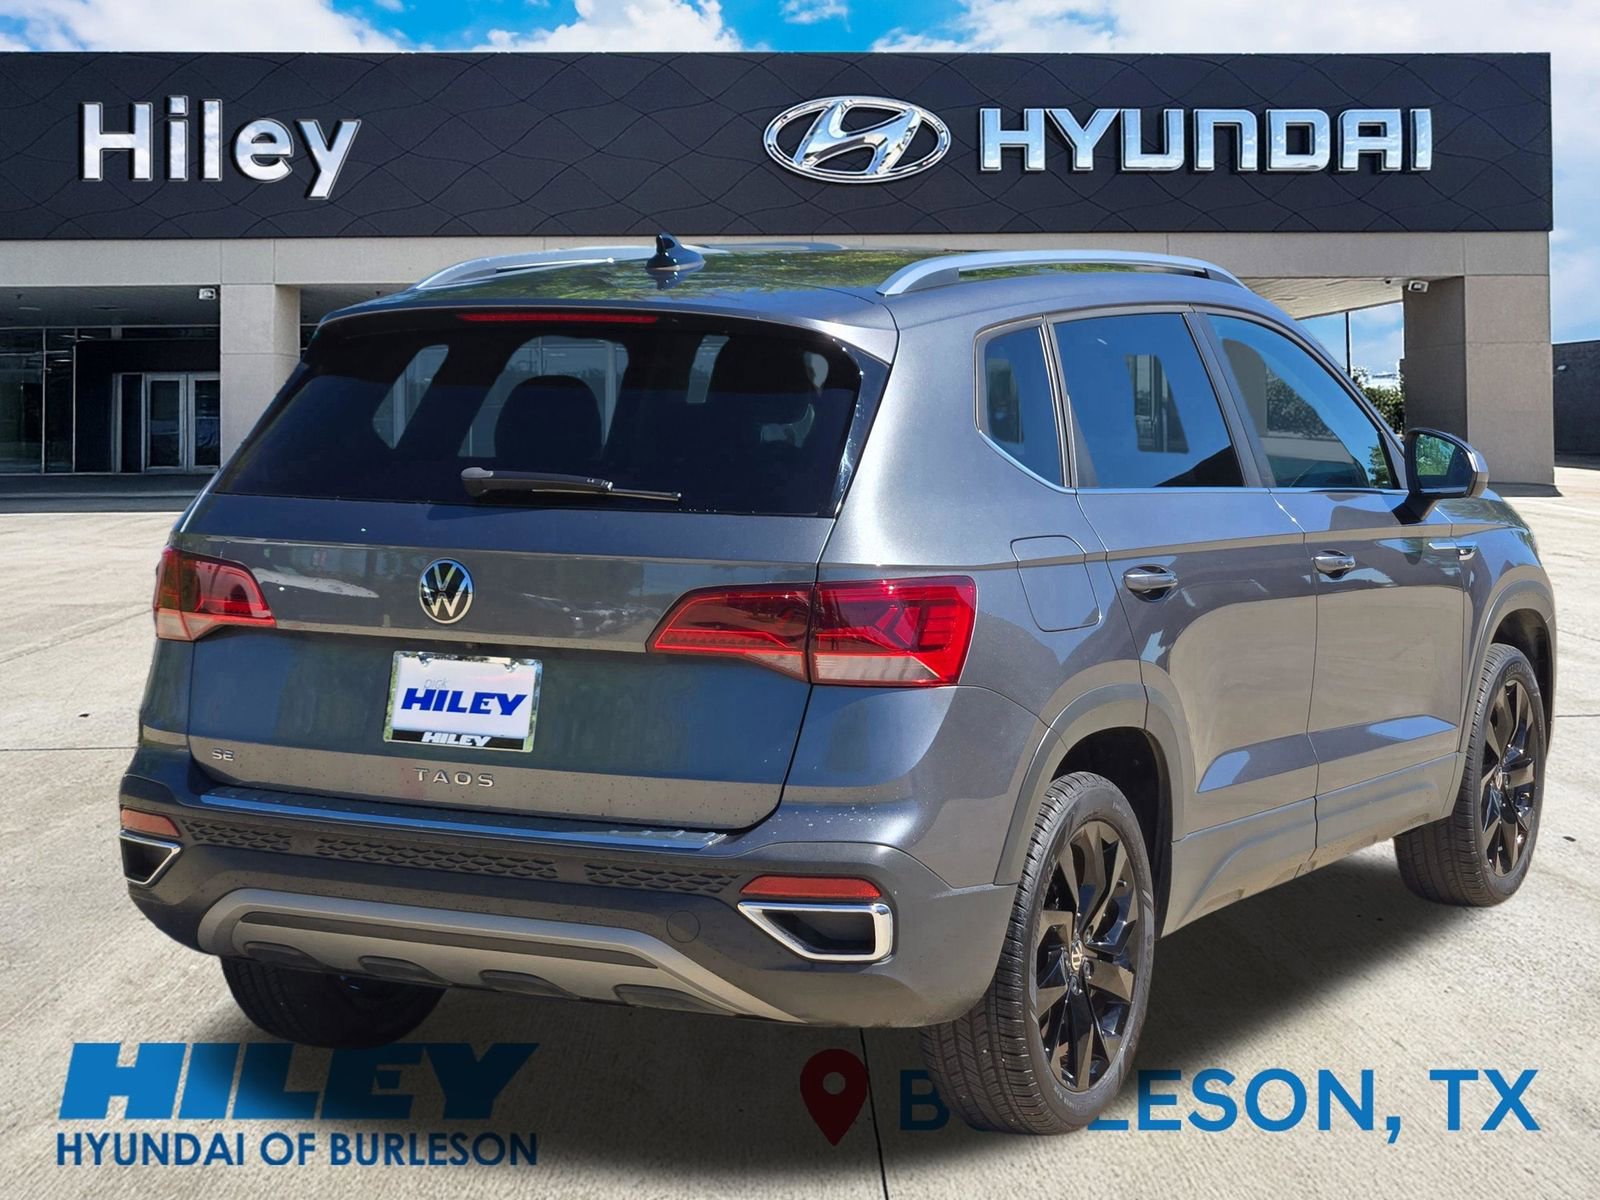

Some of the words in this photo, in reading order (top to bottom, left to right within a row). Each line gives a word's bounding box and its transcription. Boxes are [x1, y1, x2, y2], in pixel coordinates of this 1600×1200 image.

[81, 95, 362, 200] Hiley
[980, 107, 1433, 172] HYUNDAI
[400, 688, 528, 716] HILEY
[421, 731, 492, 747] HILEY
[211, 747, 234, 761] SE
[414, 768, 495, 788] TAOS
